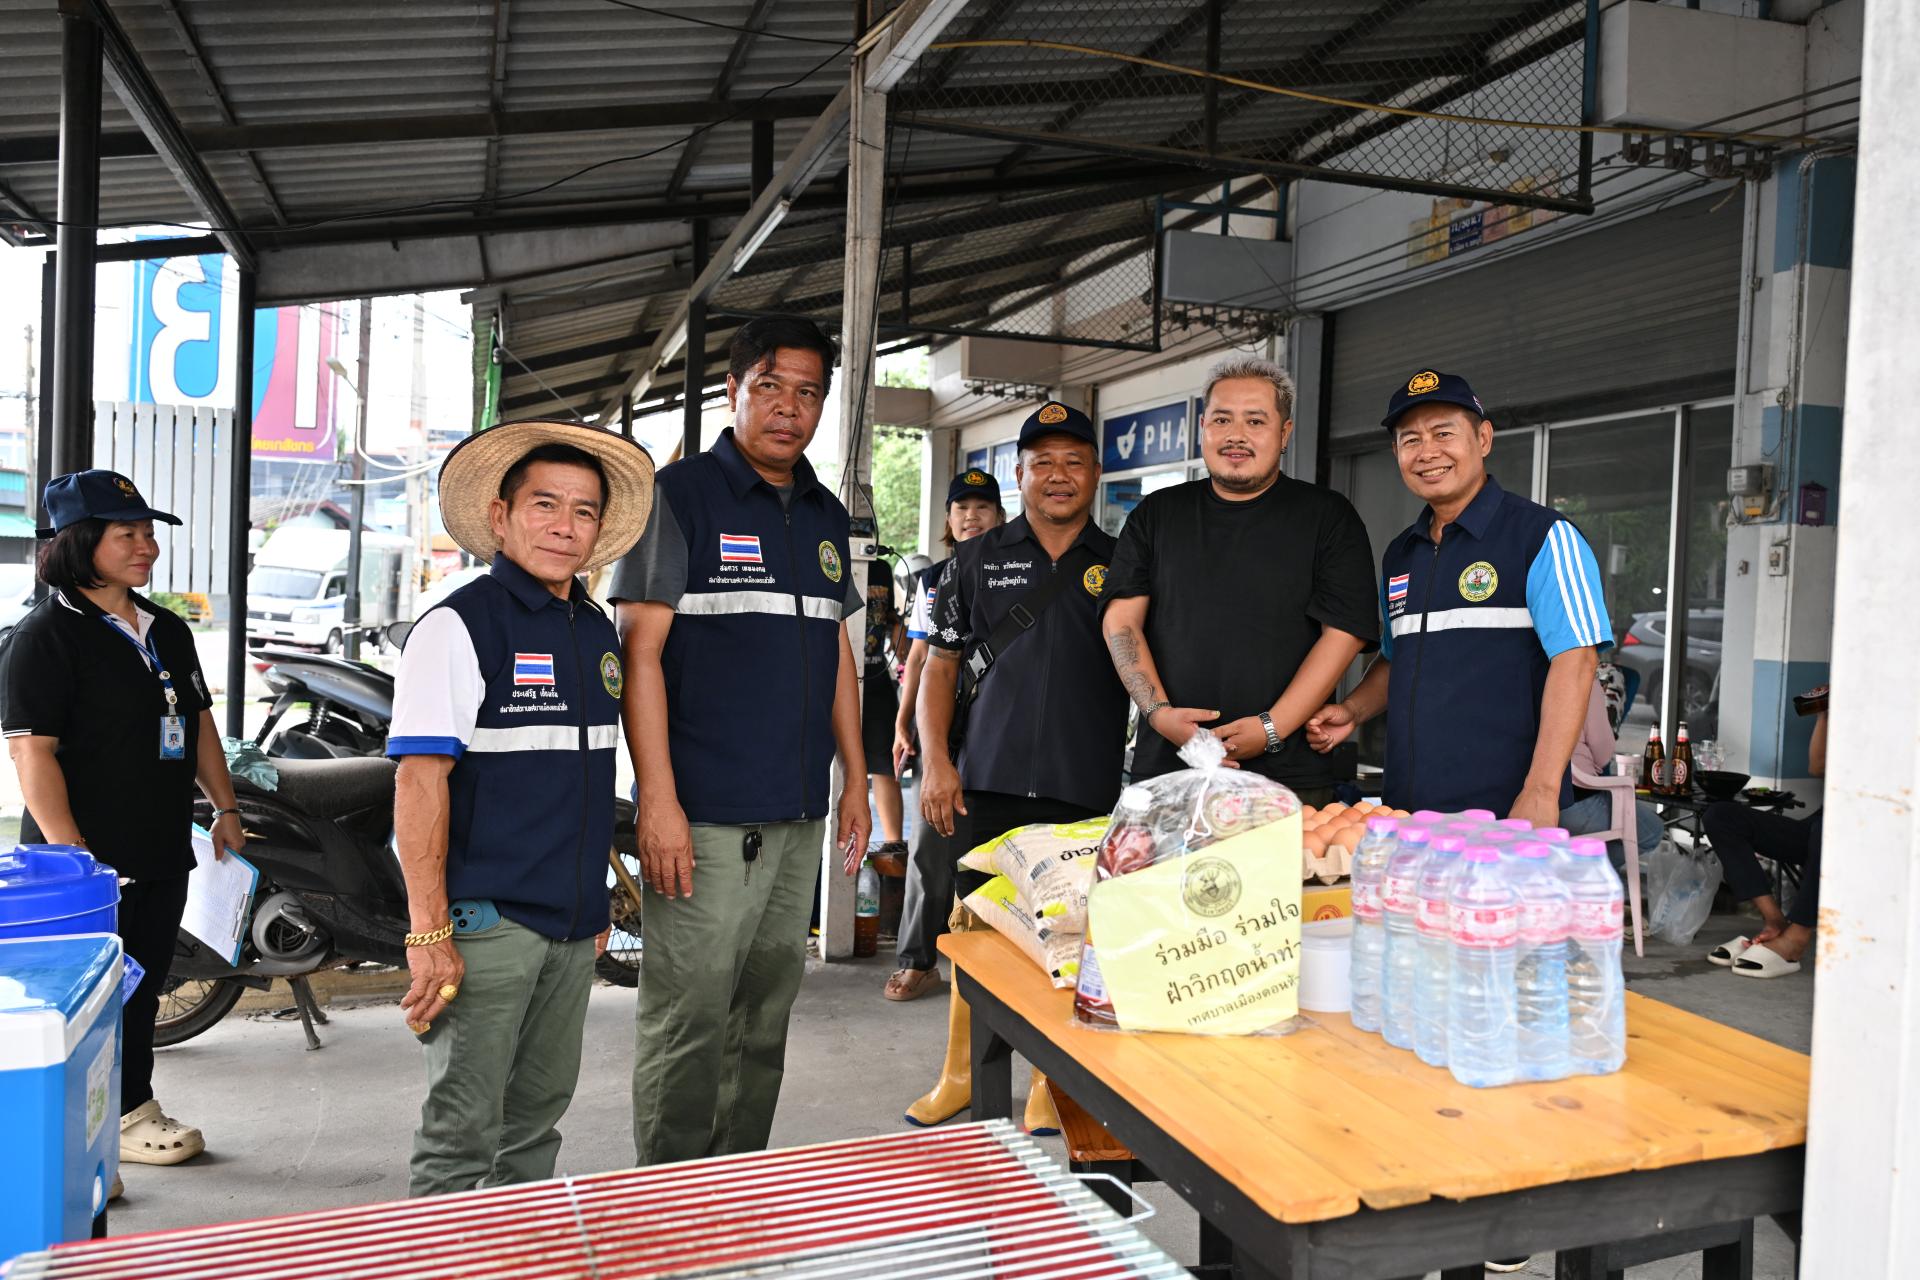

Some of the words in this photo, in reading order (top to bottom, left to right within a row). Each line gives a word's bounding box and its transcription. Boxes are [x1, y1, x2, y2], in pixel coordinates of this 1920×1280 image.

[1144, 413, 1203, 455] PHA
[512, 688, 537, 699] ประเสริฐ
[1155, 926, 1227, 966] ร่วมมือ
[1235, 898, 1299, 936] ร่วมใจ
